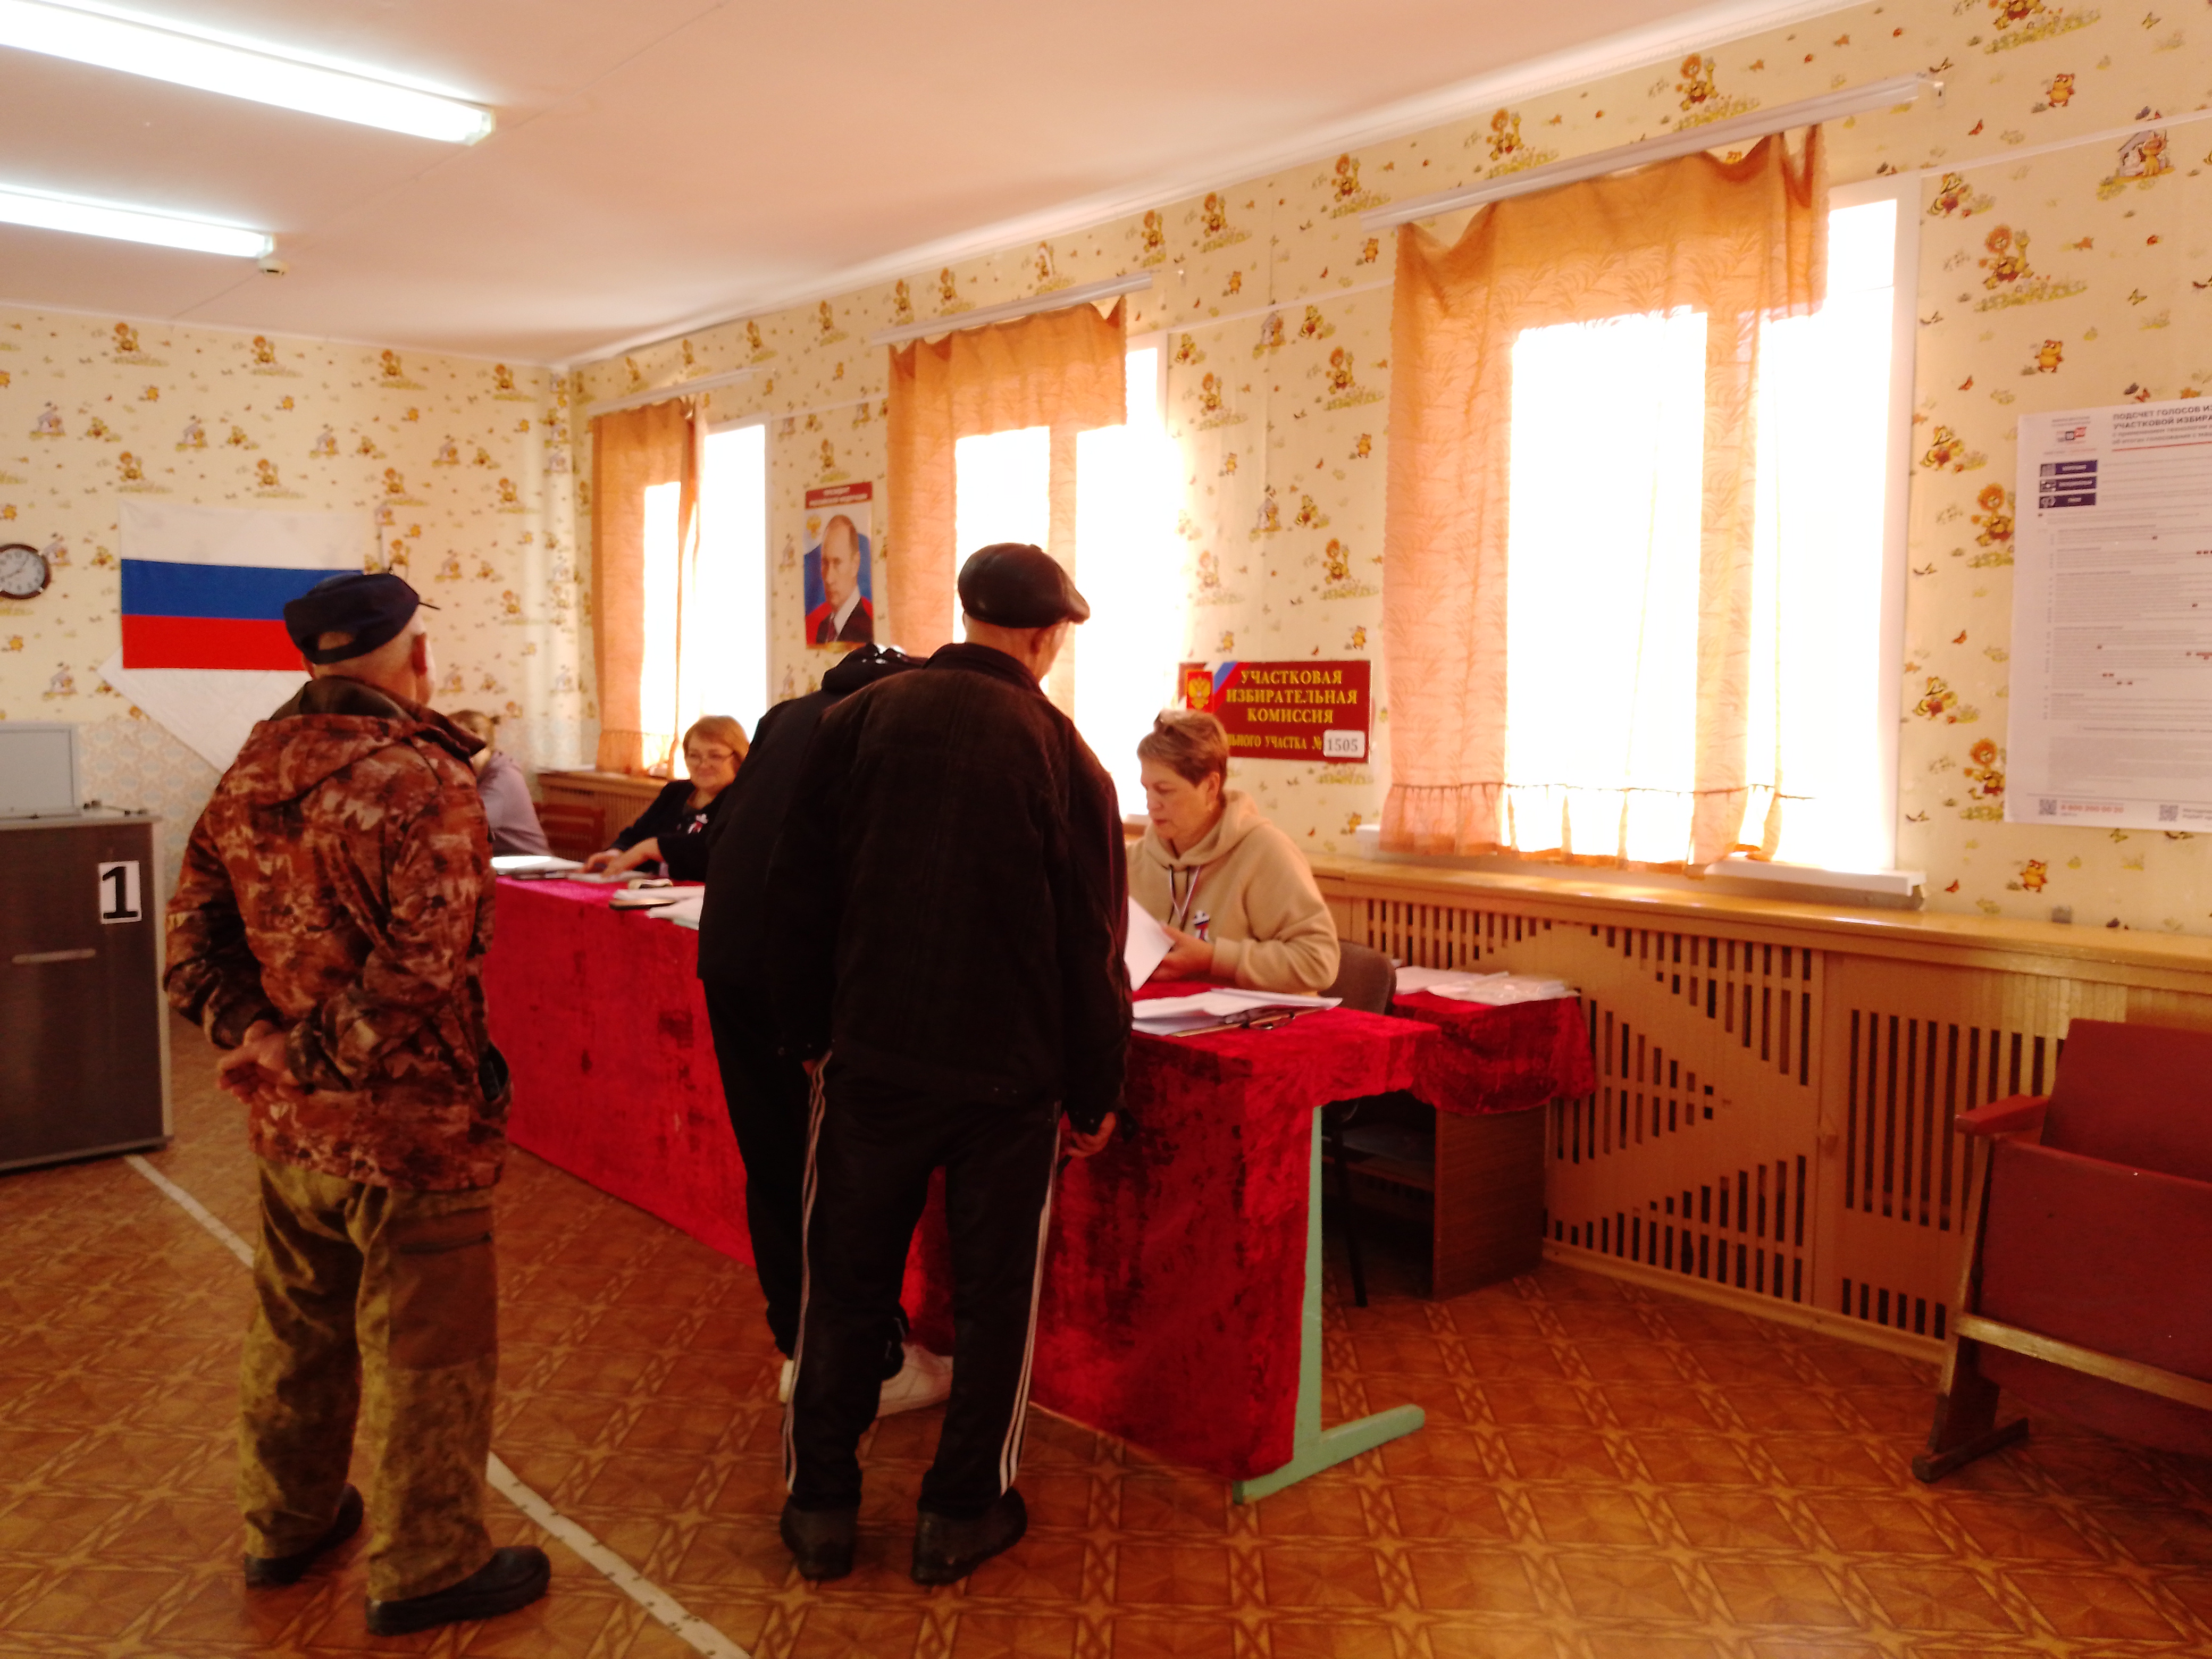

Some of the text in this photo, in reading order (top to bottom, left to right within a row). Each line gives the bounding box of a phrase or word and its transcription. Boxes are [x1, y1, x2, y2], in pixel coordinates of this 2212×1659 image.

[2113, 410, 2154, 420] ПОДСЧЕТ
[2157, 406, 2200, 416] ГОЛОСОВ
[2114, 418, 2174, 429] УЧАСТКОВОЙ
[1241, 670, 1342, 684] УЧАСТКОВАЯ
[1226, 689, 1357, 704] ИЗБИРАТЕЛЬНАЯ
[1247, 708, 1333, 723] КОМИССИЯ
[1265, 736, 1306, 749] УЧАСТКА
[1328, 738, 1358, 751] 1505
[102, 866, 138, 919] 1
